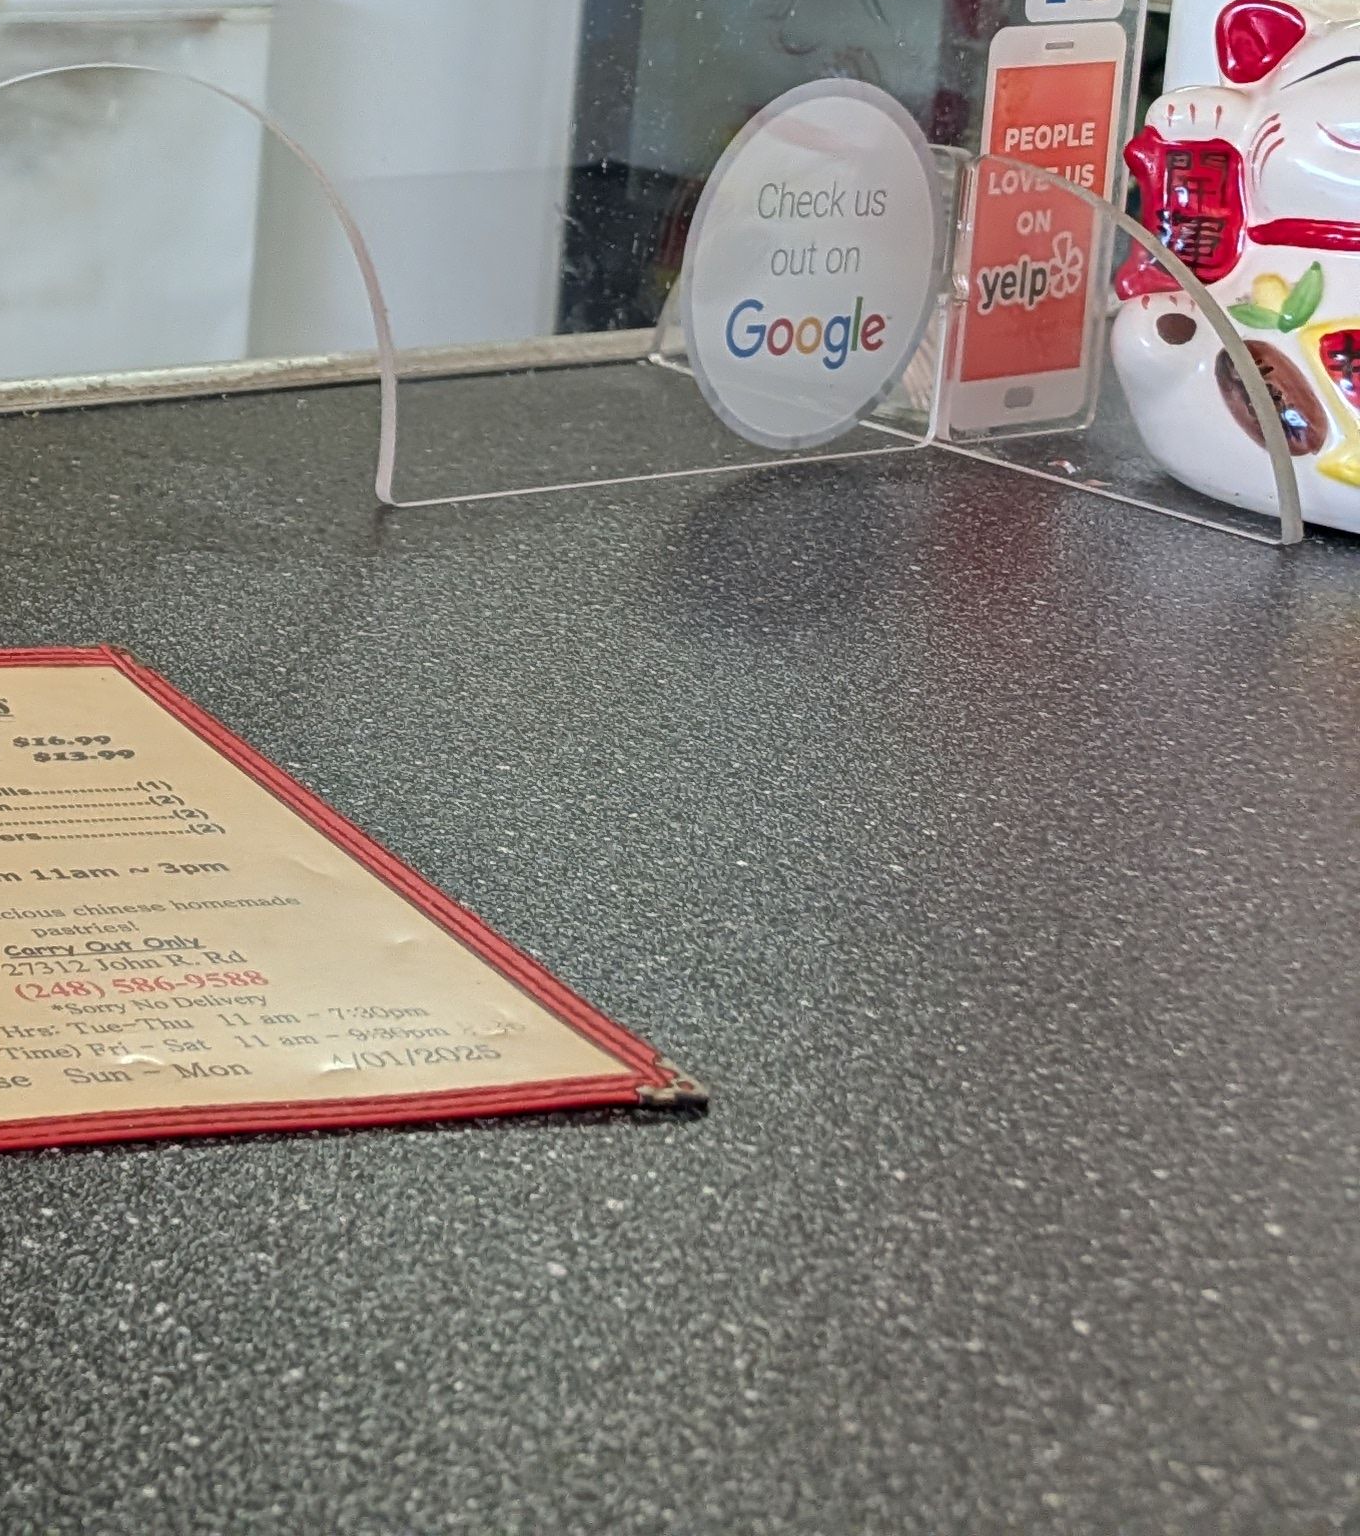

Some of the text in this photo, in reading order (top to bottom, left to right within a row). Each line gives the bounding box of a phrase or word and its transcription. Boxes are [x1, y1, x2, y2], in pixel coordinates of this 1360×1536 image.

[1004, 122, 1097, 153] PEOPLE
[758, 181, 888, 219] Check us
[1016, 209, 1052, 236] ON
[771, 242, 861, 277] out on
[980, 259, 1048, 311] yelp
[726, 296, 886, 370] Google
[12, 734, 111, 747] $16.99
[33, 749, 135, 763] $13.99
[30, 864, 121, 882] 11am
[158, 860, 229, 876] 3pm
[72, 899, 166, 917] chinese
[171, 894, 301, 913] homemade
[30, 920, 139, 939] pastries!
[3, 936, 204, 959] Carry Out Only
[1, 949, 248, 978] 27312 John Rd
[14, 970, 269, 1001] (248) 586-9588
[132, 993, 268, 1011] No Delivery
[0, 1024, 61, 1039] Hrs:
[219, 1013, 252, 1027] 11
[259, 1012, 301, 1024] am
[86, 1041, 128, 1057] Fri
[163, 1038, 213, 1054] Sat
[234, 1034, 270, 1048] 11
[278, 1033, 321, 1046] am
[63, 1066, 135, 1085] Sun
[172, 1062, 253, 1080] Mon
